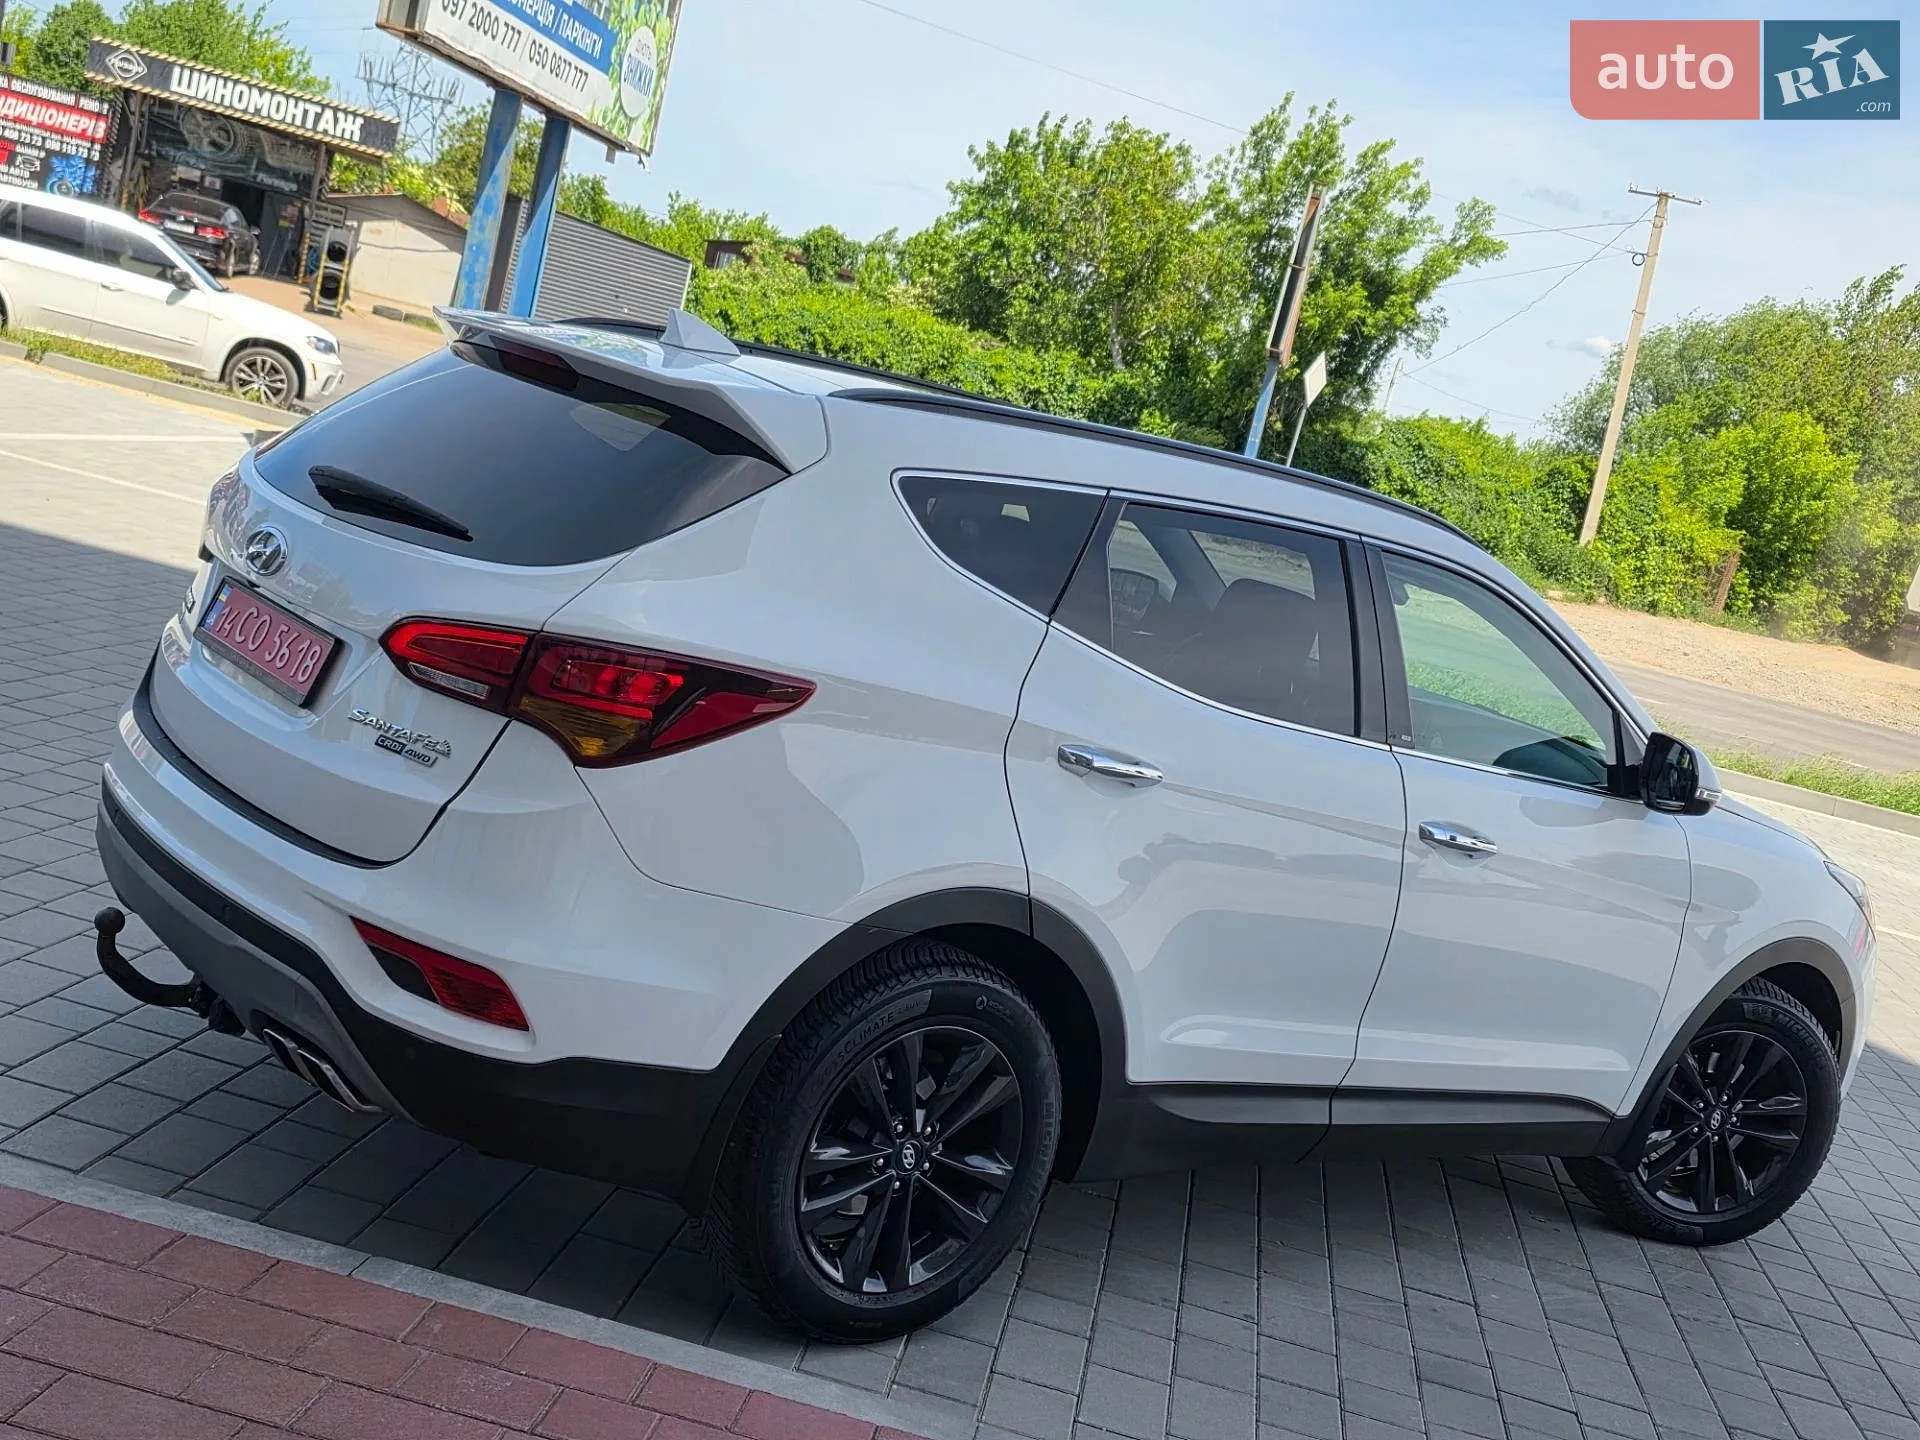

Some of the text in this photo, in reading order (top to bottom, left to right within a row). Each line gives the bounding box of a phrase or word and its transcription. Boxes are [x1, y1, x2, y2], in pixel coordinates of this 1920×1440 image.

[442, 0, 589, 92] 097 2000 777 050 0877 777
[511, 0, 556, 28] ЕРЦІЯ
[559, 11, 603, 59] ПАРКІНГИ
[79, 95, 109, 115] РЕМОТ
[170, 65, 365, 142] ШИНОМОНТАЖ
[264, 623, 324, 685] 5618
[348, 708, 413, 743] SANTA
[405, 748, 432, 763] 4WD
